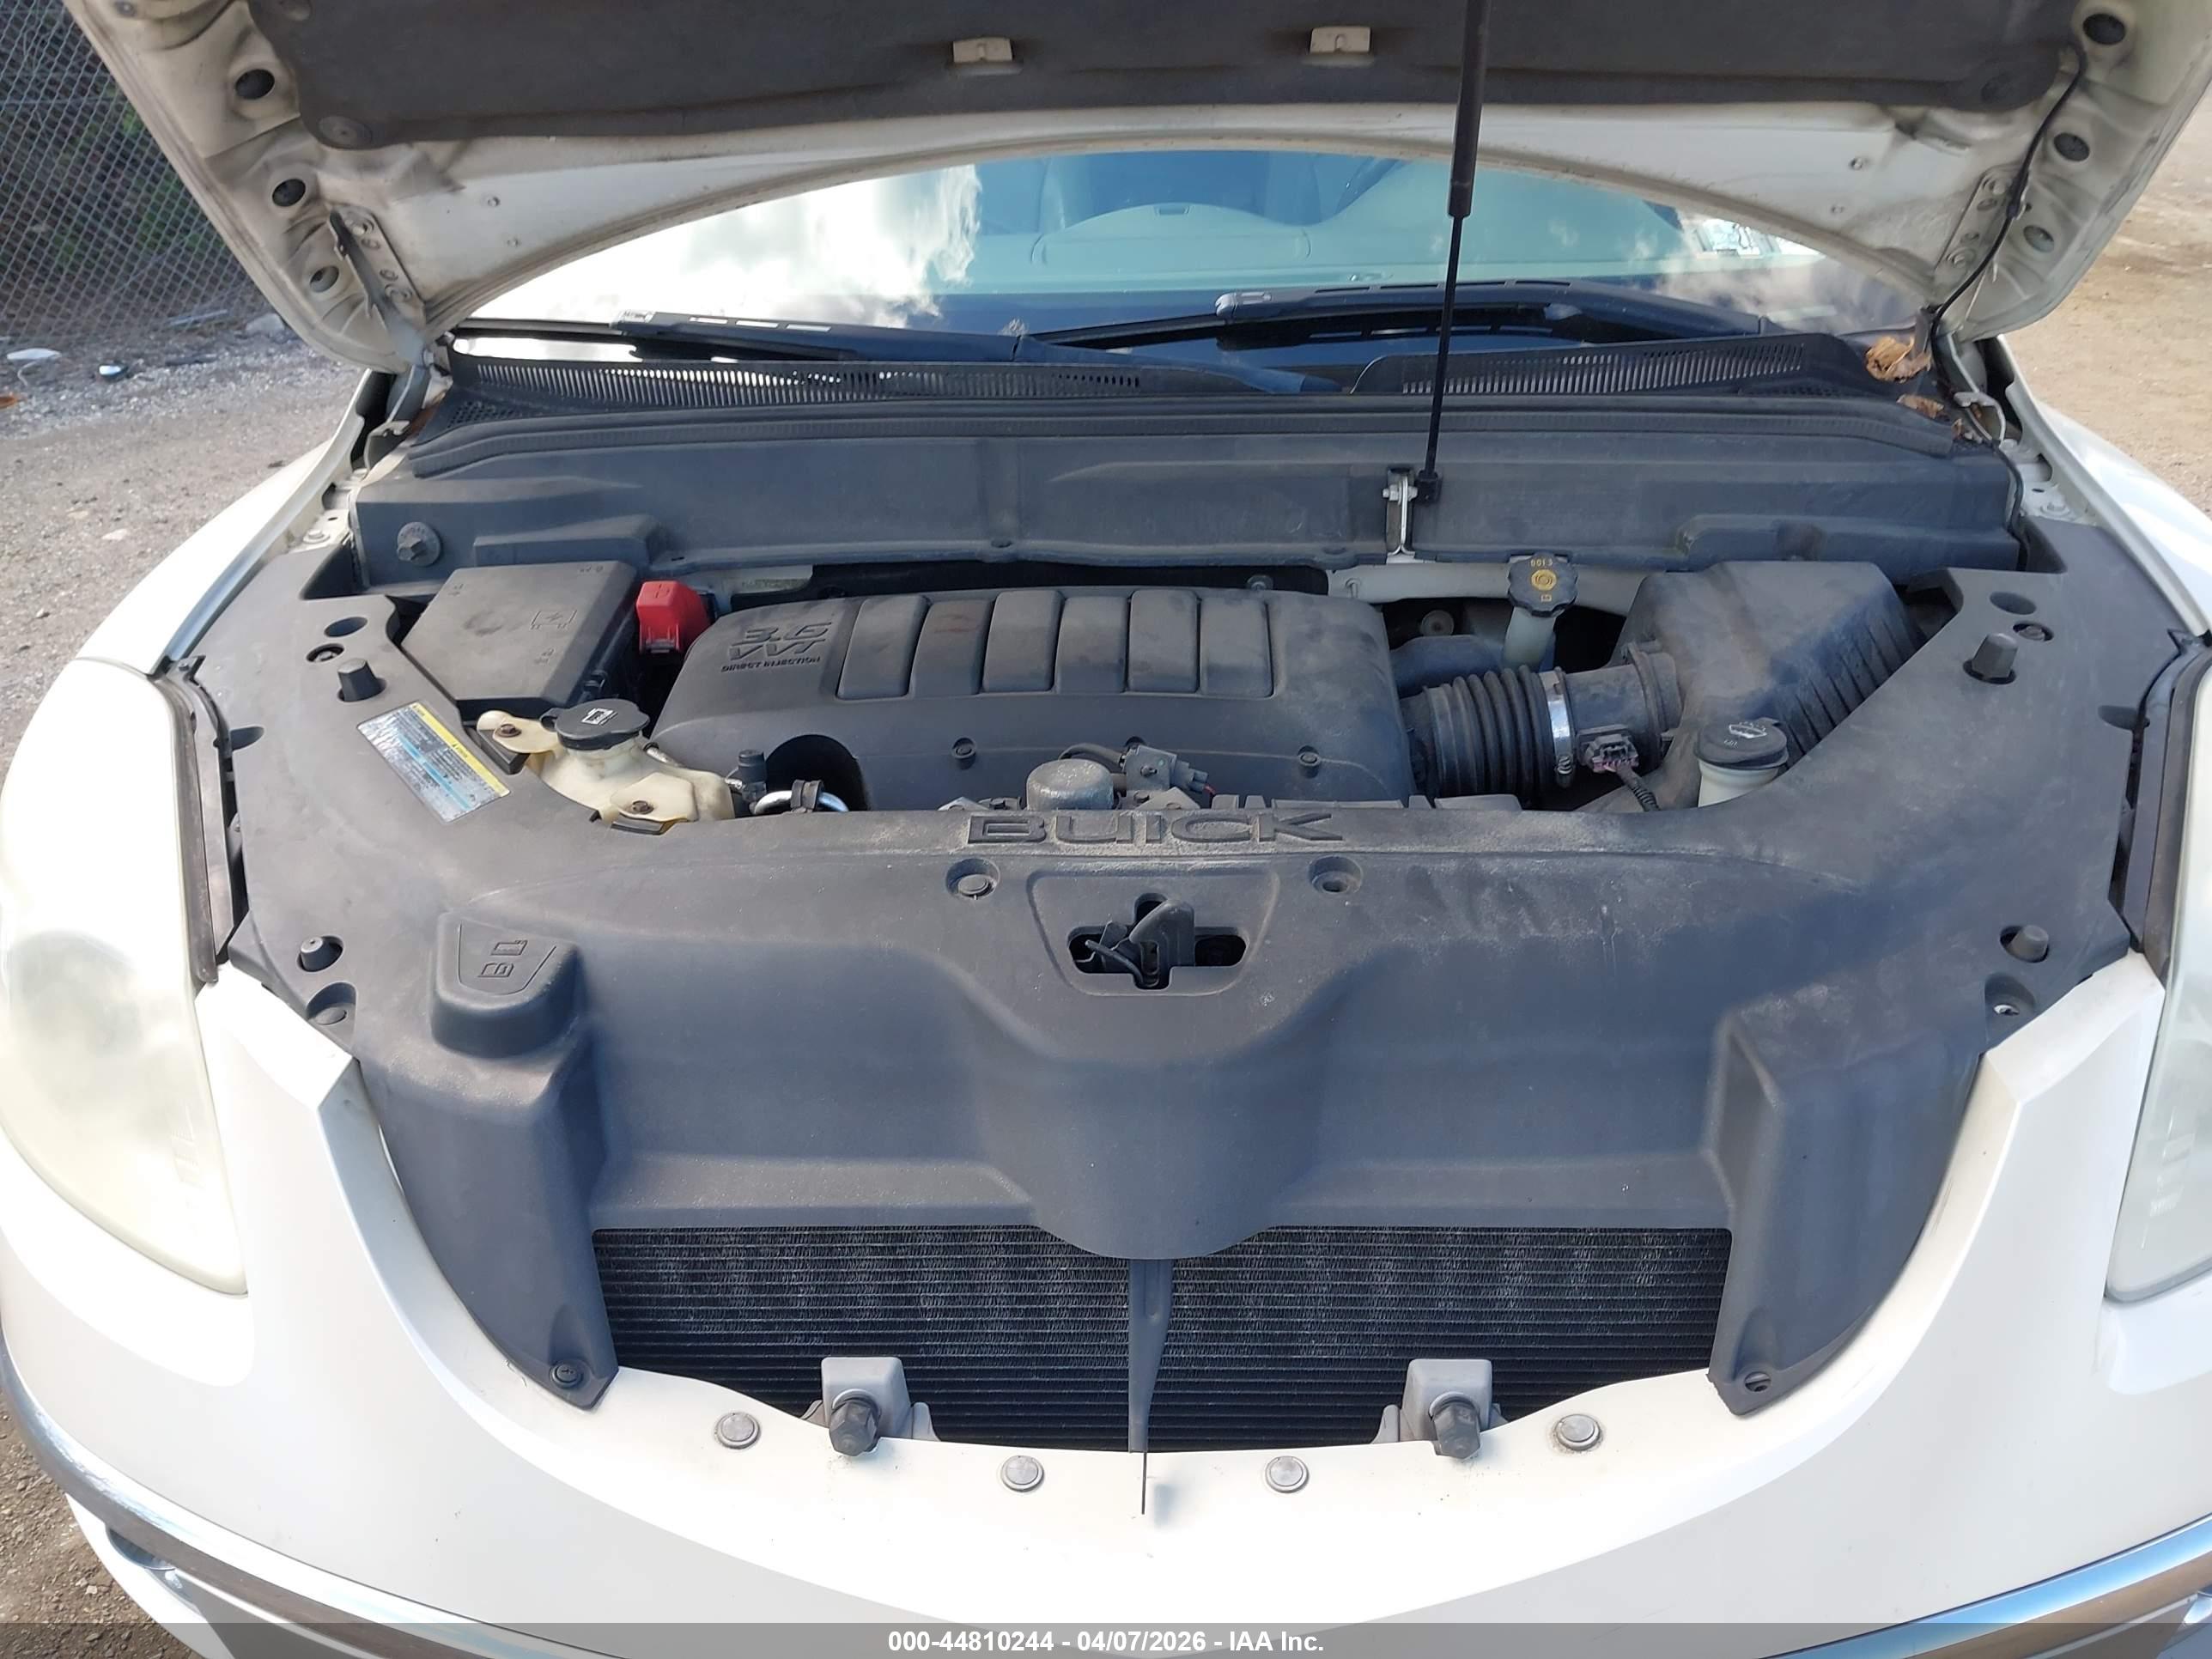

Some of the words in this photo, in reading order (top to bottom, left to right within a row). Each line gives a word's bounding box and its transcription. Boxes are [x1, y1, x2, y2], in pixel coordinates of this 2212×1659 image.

[737, 622, 832, 644] 3.6
[729, 639, 826, 661] VVT
[721, 659, 761, 672] DIRECT
[763, 655, 822, 667] INJECTION
[967, 811, 1343, 844] BUICK
